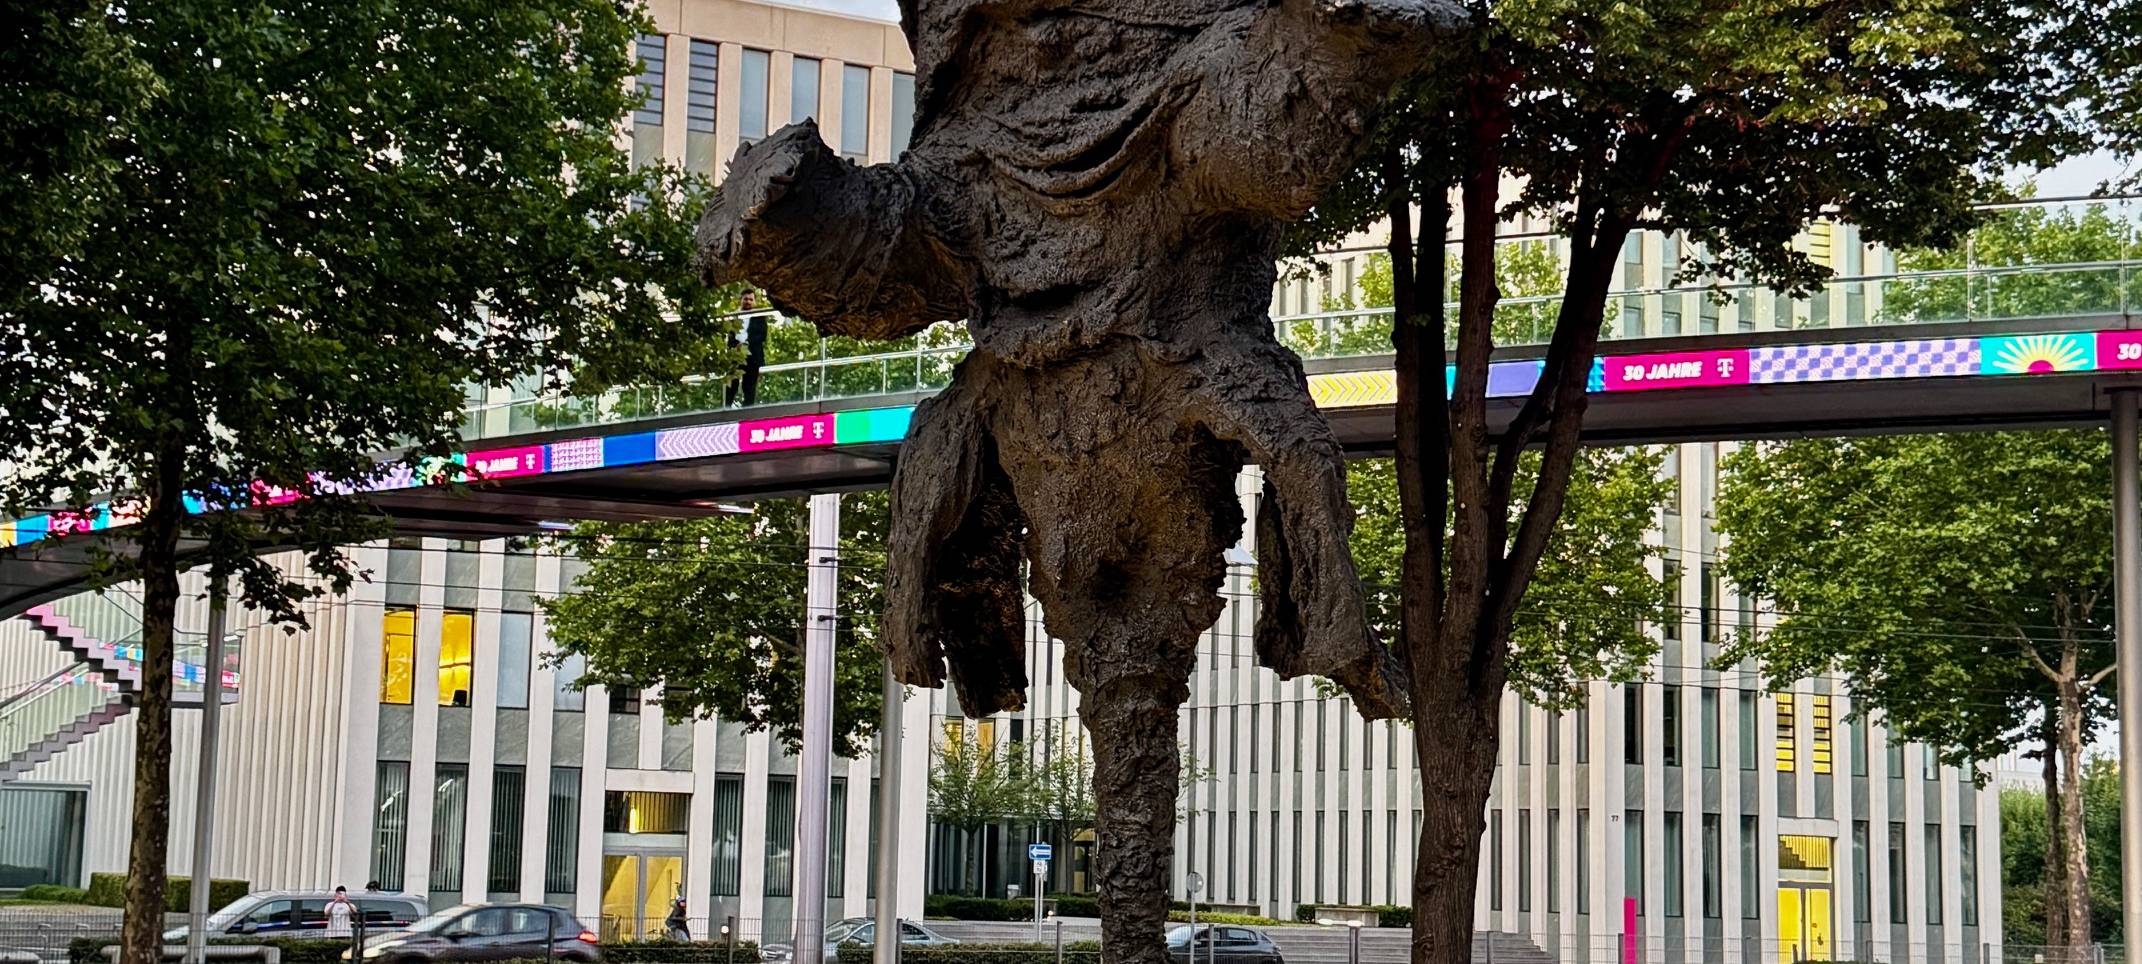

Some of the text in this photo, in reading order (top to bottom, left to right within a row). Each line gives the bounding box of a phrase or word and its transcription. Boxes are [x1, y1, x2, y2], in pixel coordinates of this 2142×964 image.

[2117, 343, 2142, 360] 30
[1623, 365, 1645, 381] 30
[1646, 361, 1703, 379] JAHRE
[750, 429, 765, 443] 30
[765, 425, 804, 442] JAHRE
